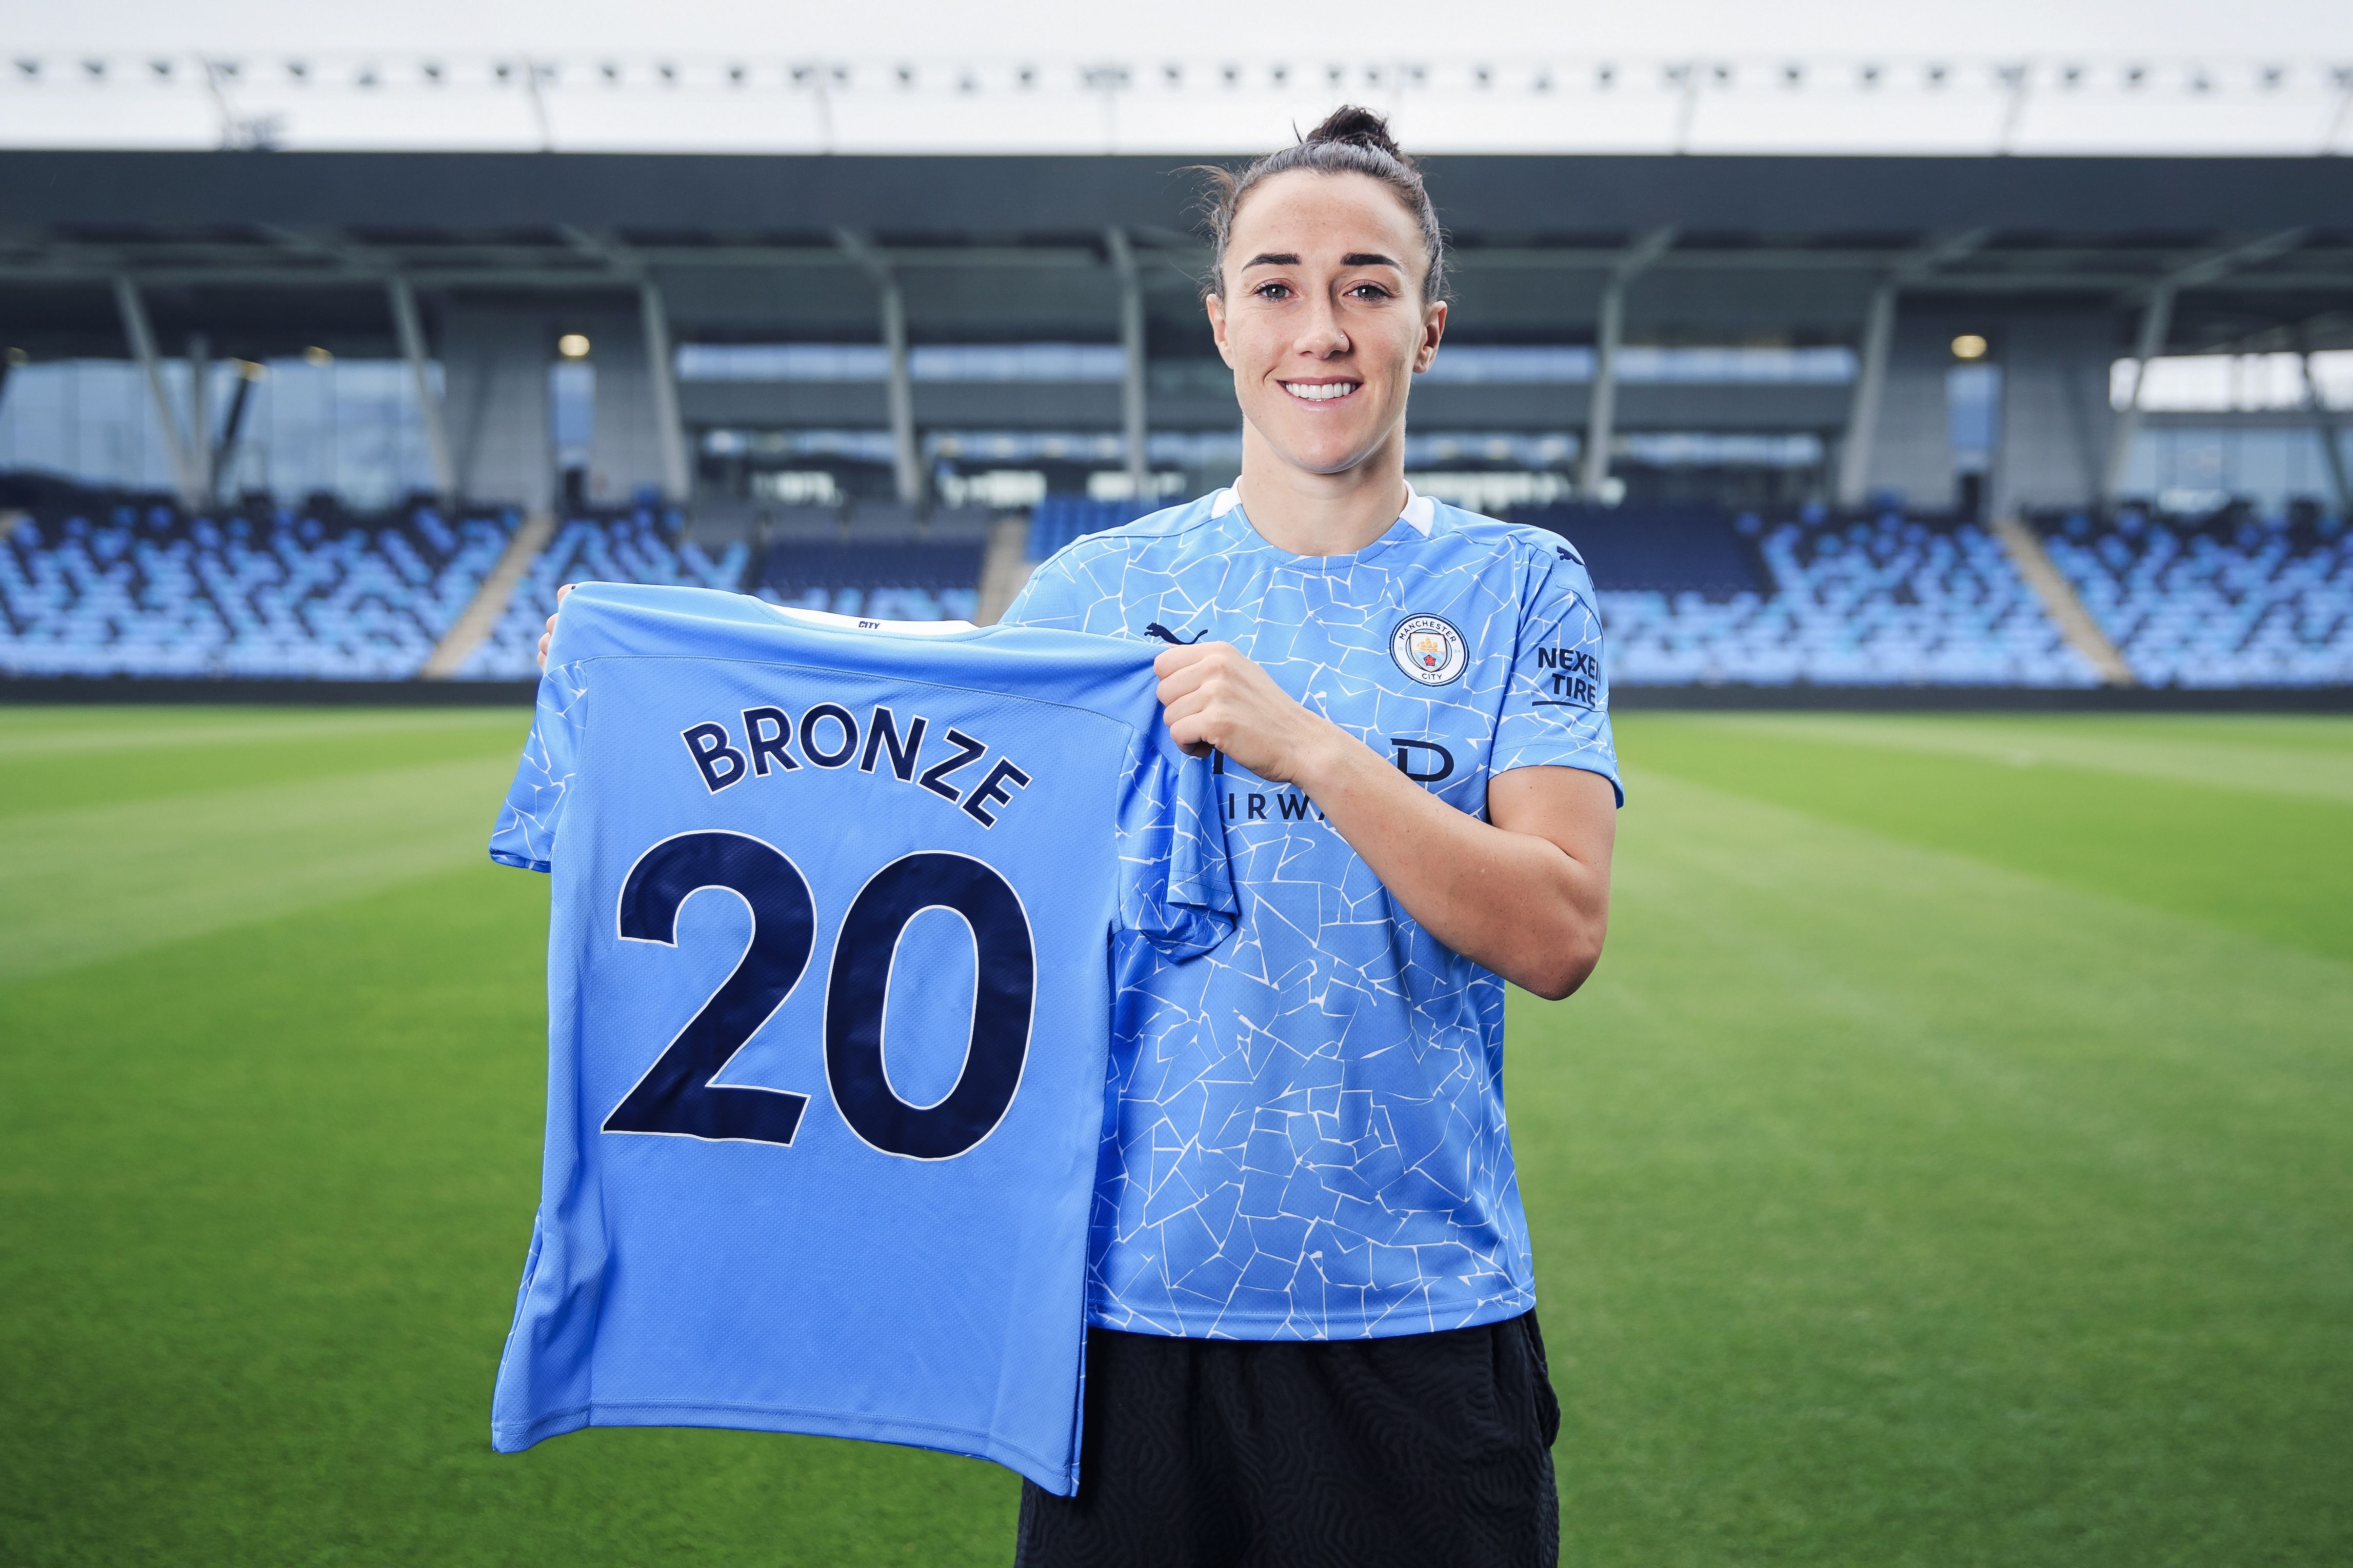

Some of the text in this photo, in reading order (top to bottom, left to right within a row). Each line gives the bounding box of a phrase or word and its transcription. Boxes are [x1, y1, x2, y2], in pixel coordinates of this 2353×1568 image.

[858, 621, 881, 629] CITY
[1399, 620, 1457, 642] MANCHESTER
[1551, 672, 1596, 708] TIRE
[680, 701, 1033, 830] BRONZE
[600, 828, 1038, 1162] 20
